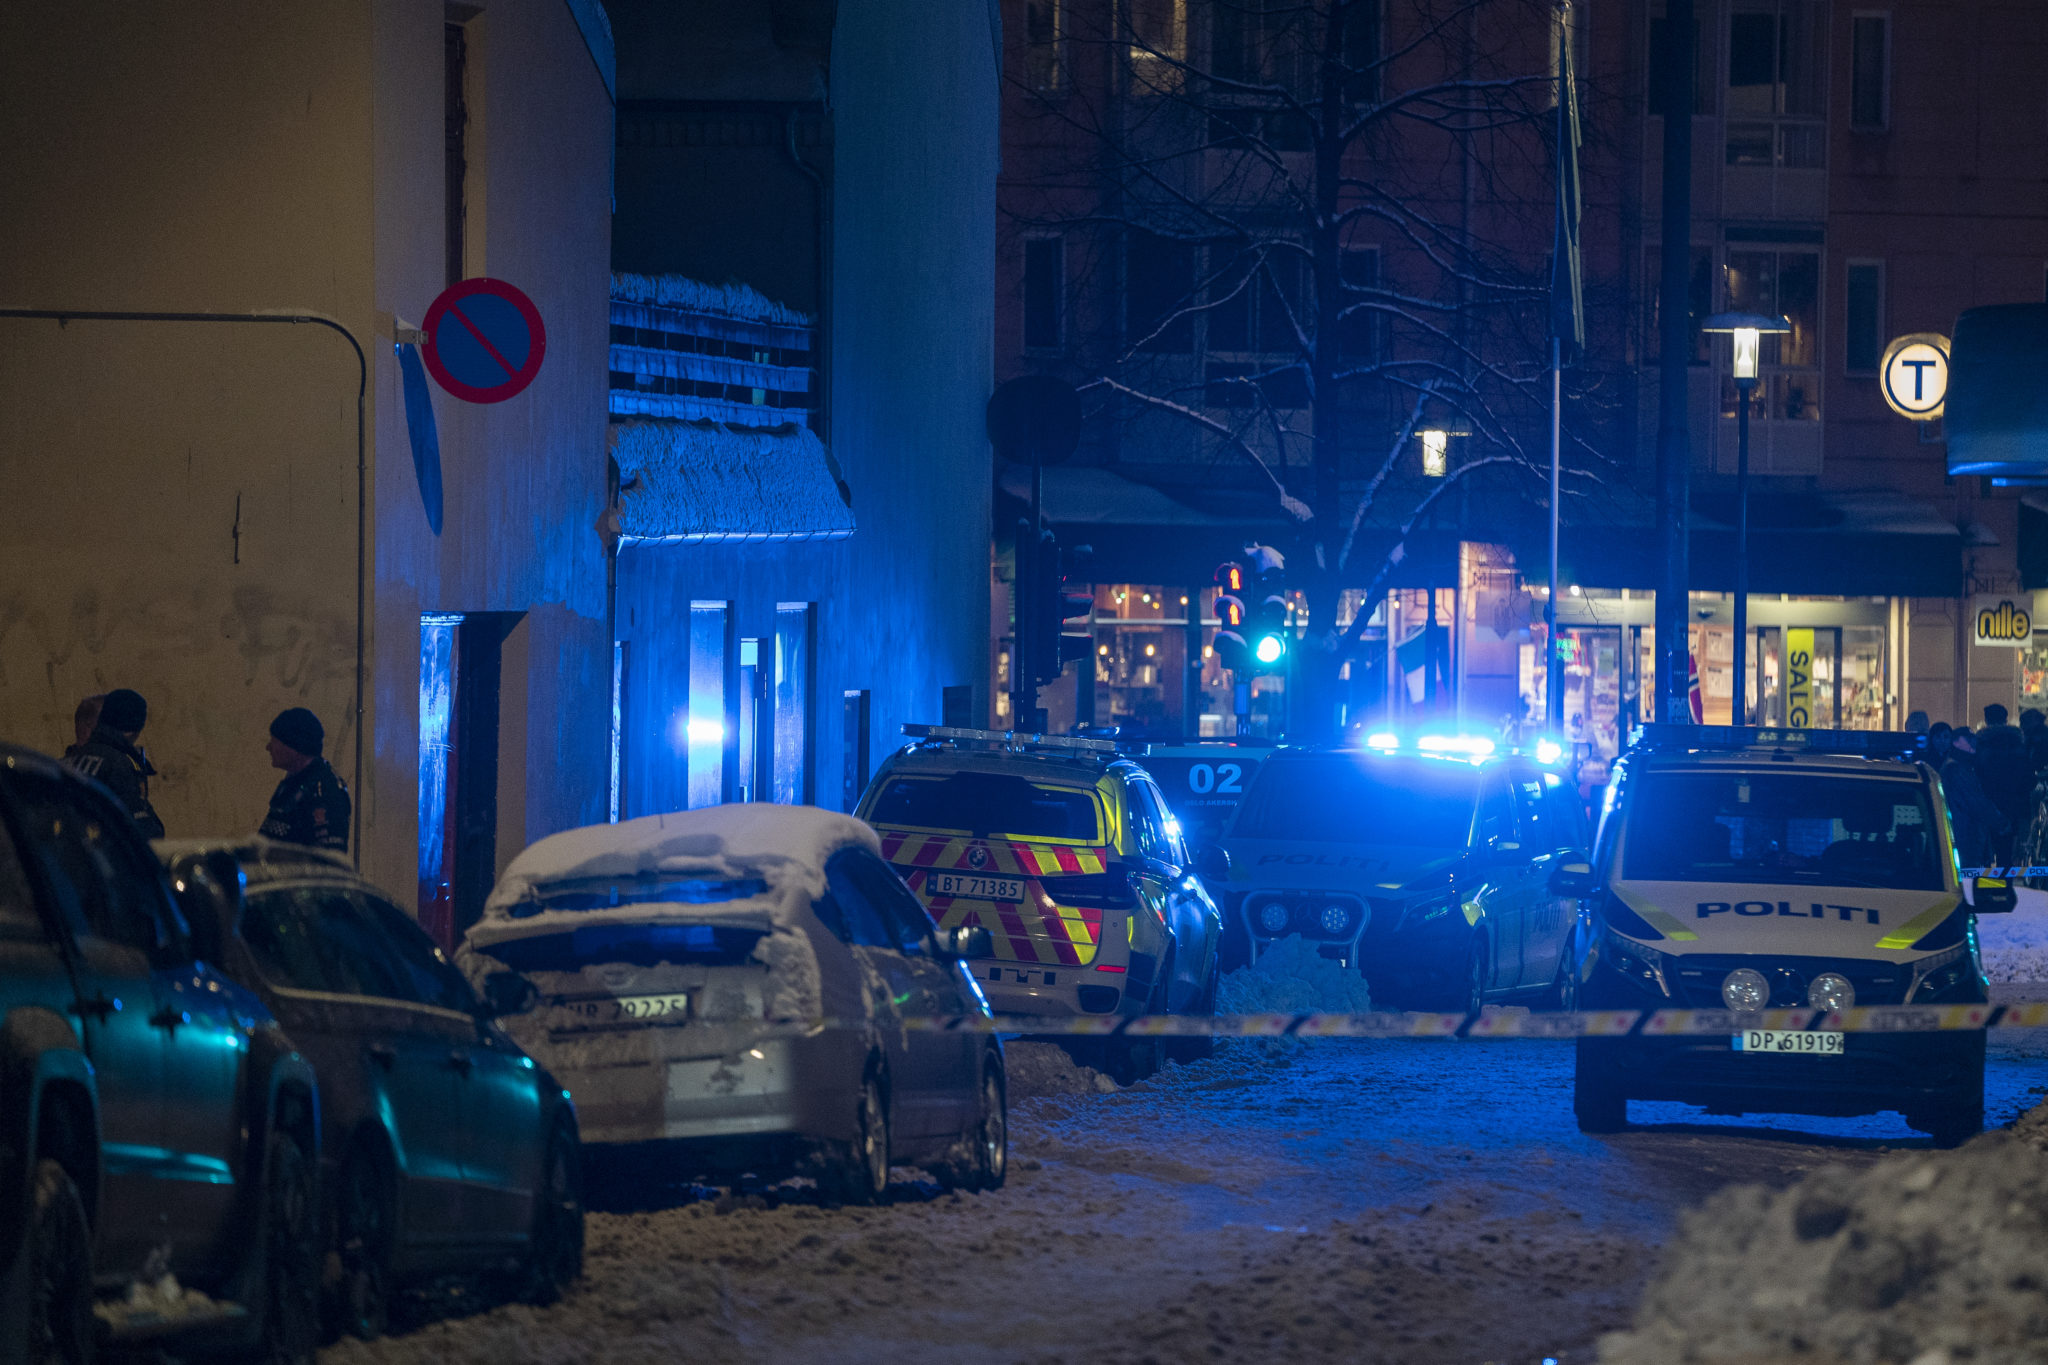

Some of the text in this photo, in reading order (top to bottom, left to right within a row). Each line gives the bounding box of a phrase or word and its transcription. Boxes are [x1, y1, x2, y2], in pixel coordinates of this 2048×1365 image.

[1902, 360, 1936, 401] T
[1978, 600, 2031, 640] nille
[1790, 650, 1809, 728] SALG
[1188, 763, 1243, 794] 02
[1256, 853, 1391, 872] POLITI
[943, 876, 1018, 897] BT 71385
[1696, 901, 1880, 925] POLITI
[1749, 1032, 1836, 1051] DP 61919
